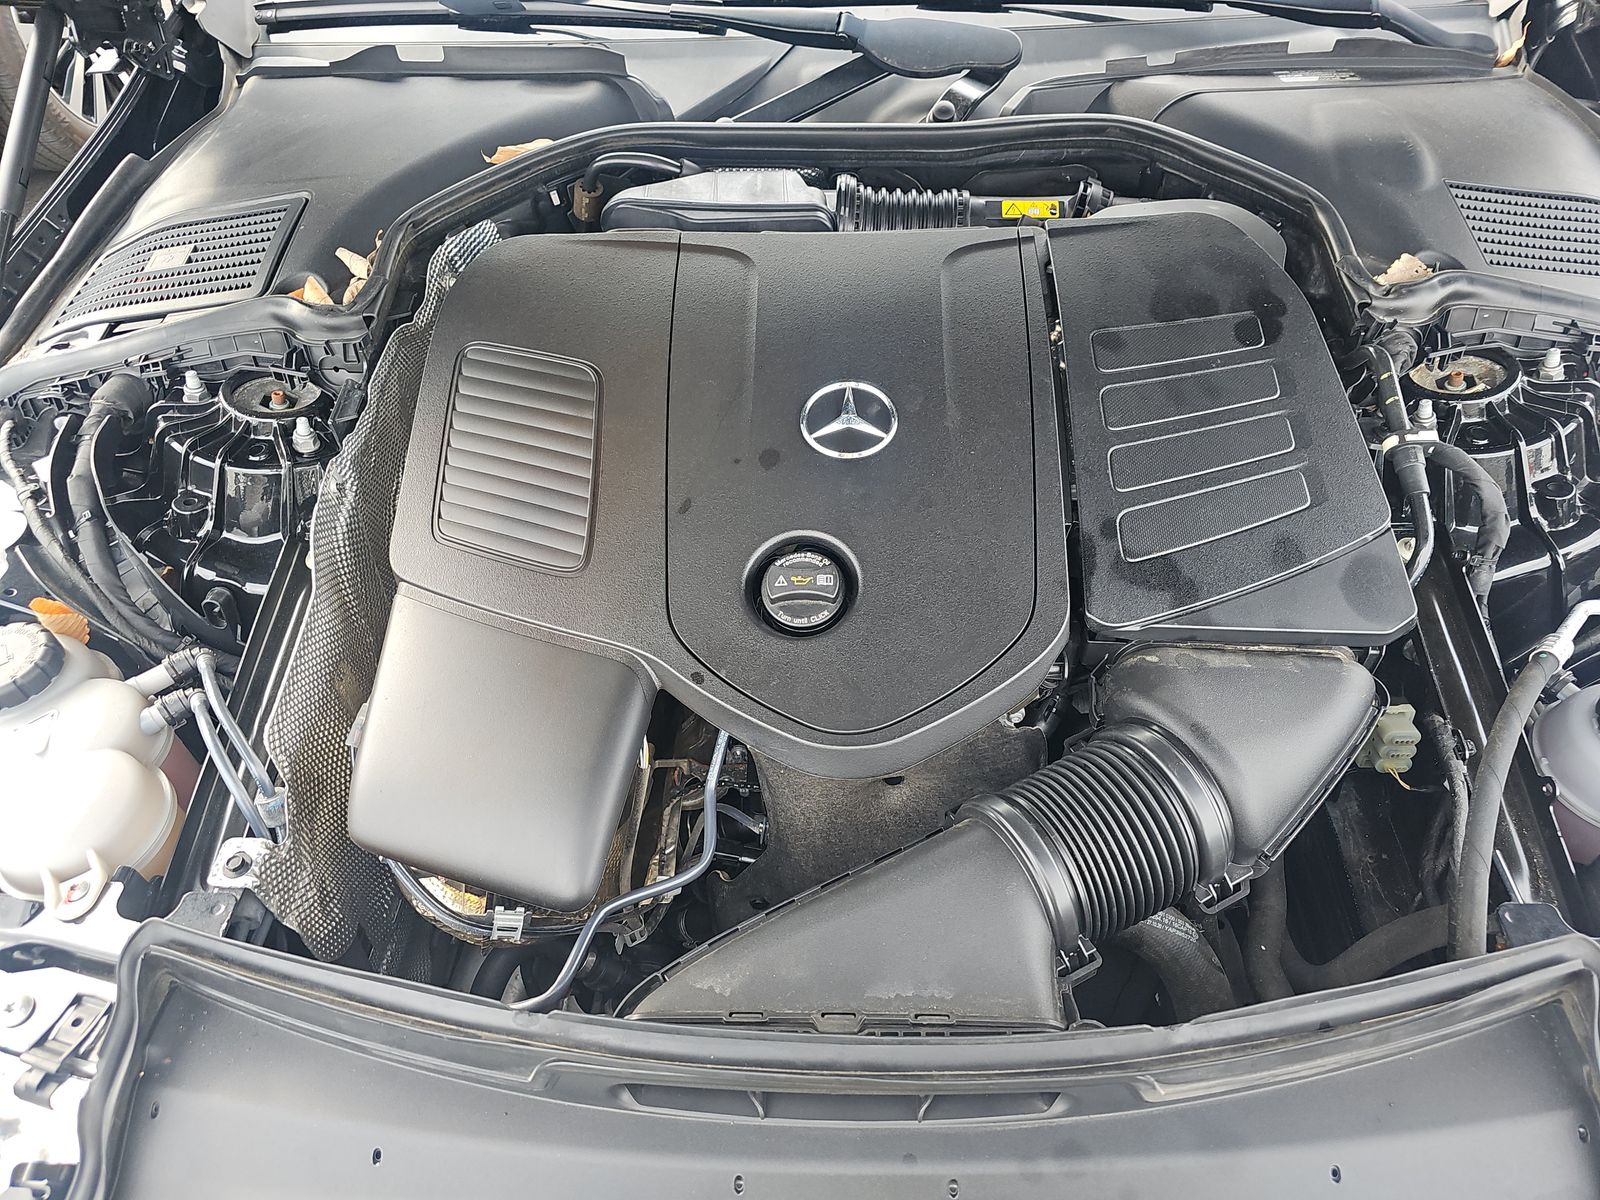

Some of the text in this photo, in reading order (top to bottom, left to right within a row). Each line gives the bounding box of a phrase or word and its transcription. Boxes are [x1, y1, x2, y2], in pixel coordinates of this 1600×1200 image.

[774, 552, 831, 566] Mercedes-Benz Oil
[782, 557, 823, 567] recommended
[777, 610, 791, 622] Turn
[810, 609, 830, 623] CLICK
